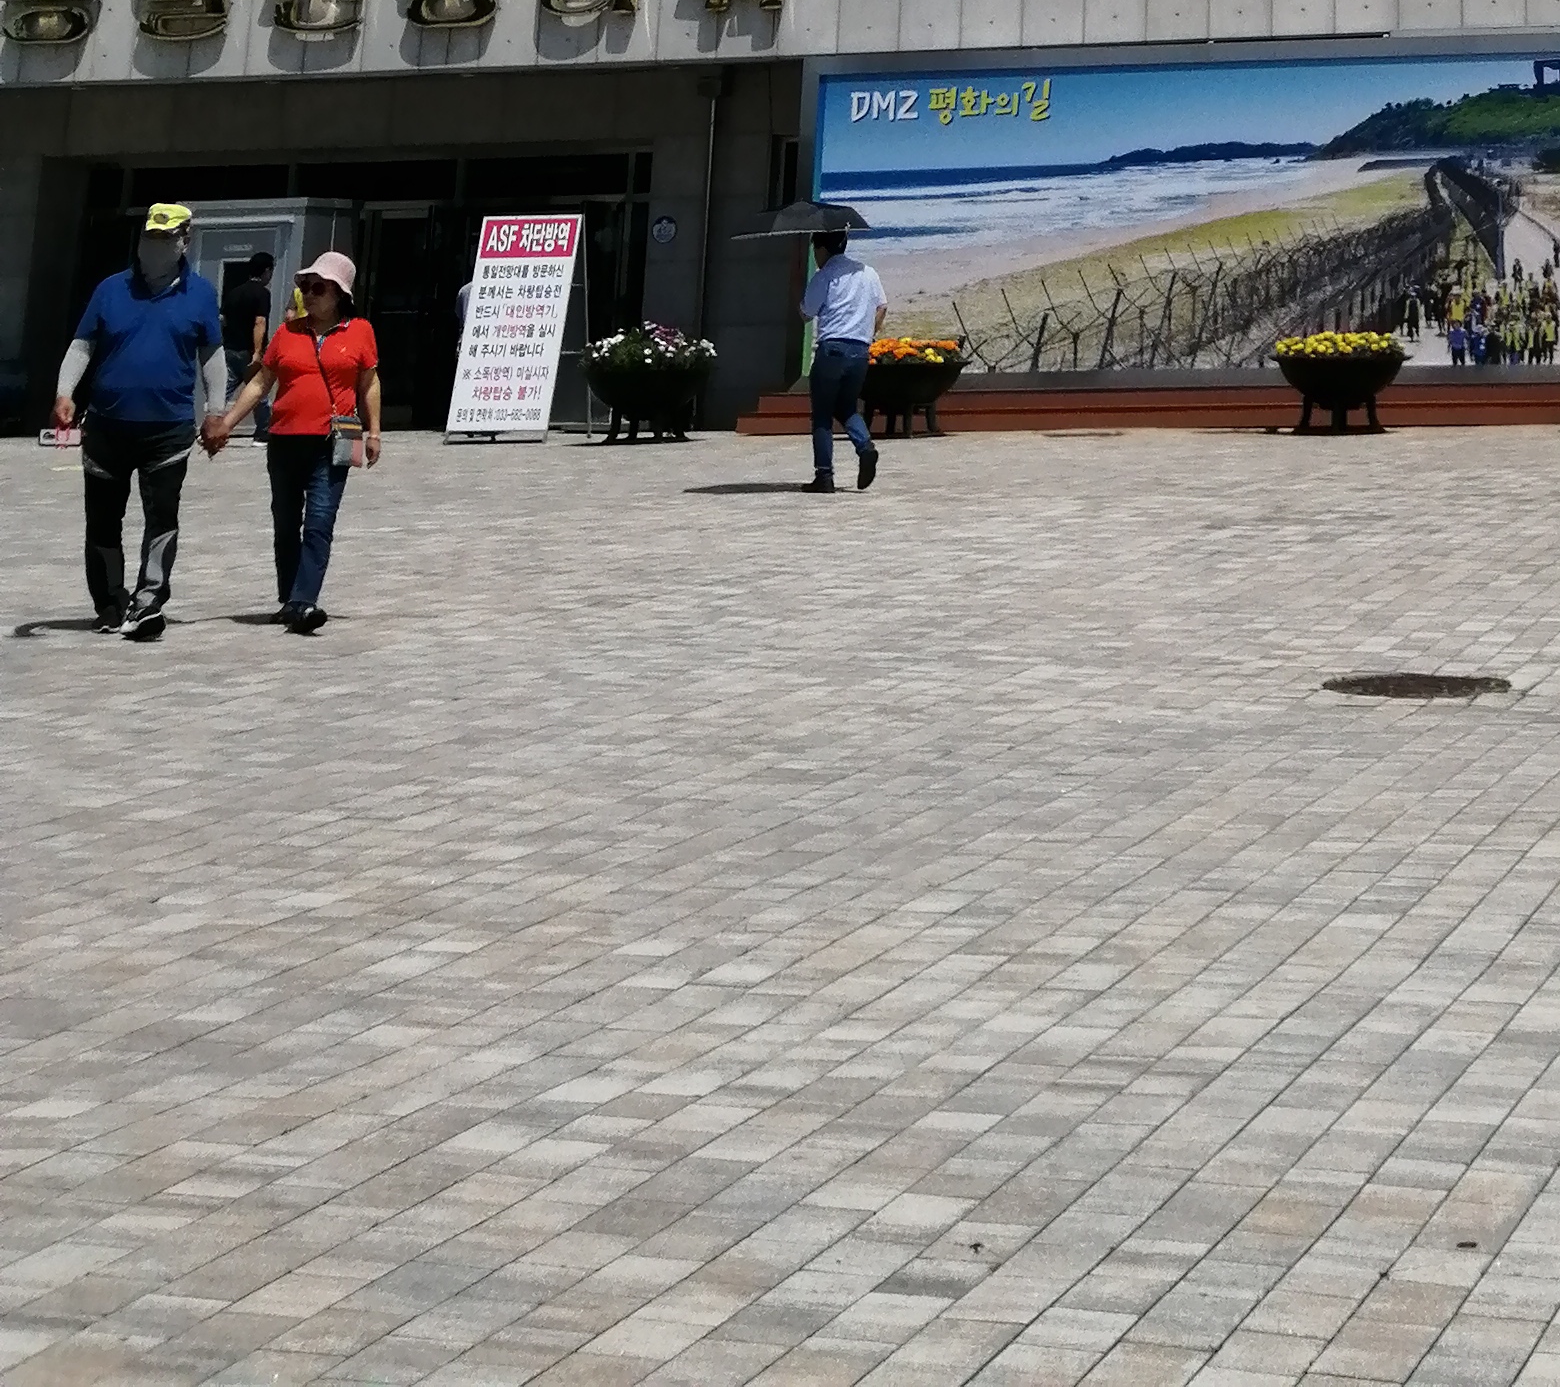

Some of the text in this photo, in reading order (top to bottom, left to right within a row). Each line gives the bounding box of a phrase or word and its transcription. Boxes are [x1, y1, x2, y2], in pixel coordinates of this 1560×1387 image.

[851, 90, 918, 123] DMZ
[486, 222, 571, 253] ASF 차단방역
[532, 264, 565, 278] 방문하신
[472, 323, 556, 339] 에서 개인방역을 실시
[468, 342, 544, 358] 해 주시기 바랍니다
[516, 365, 549, 380] 미실시자
[471, 385, 542, 401] 차량탑승 불가!
